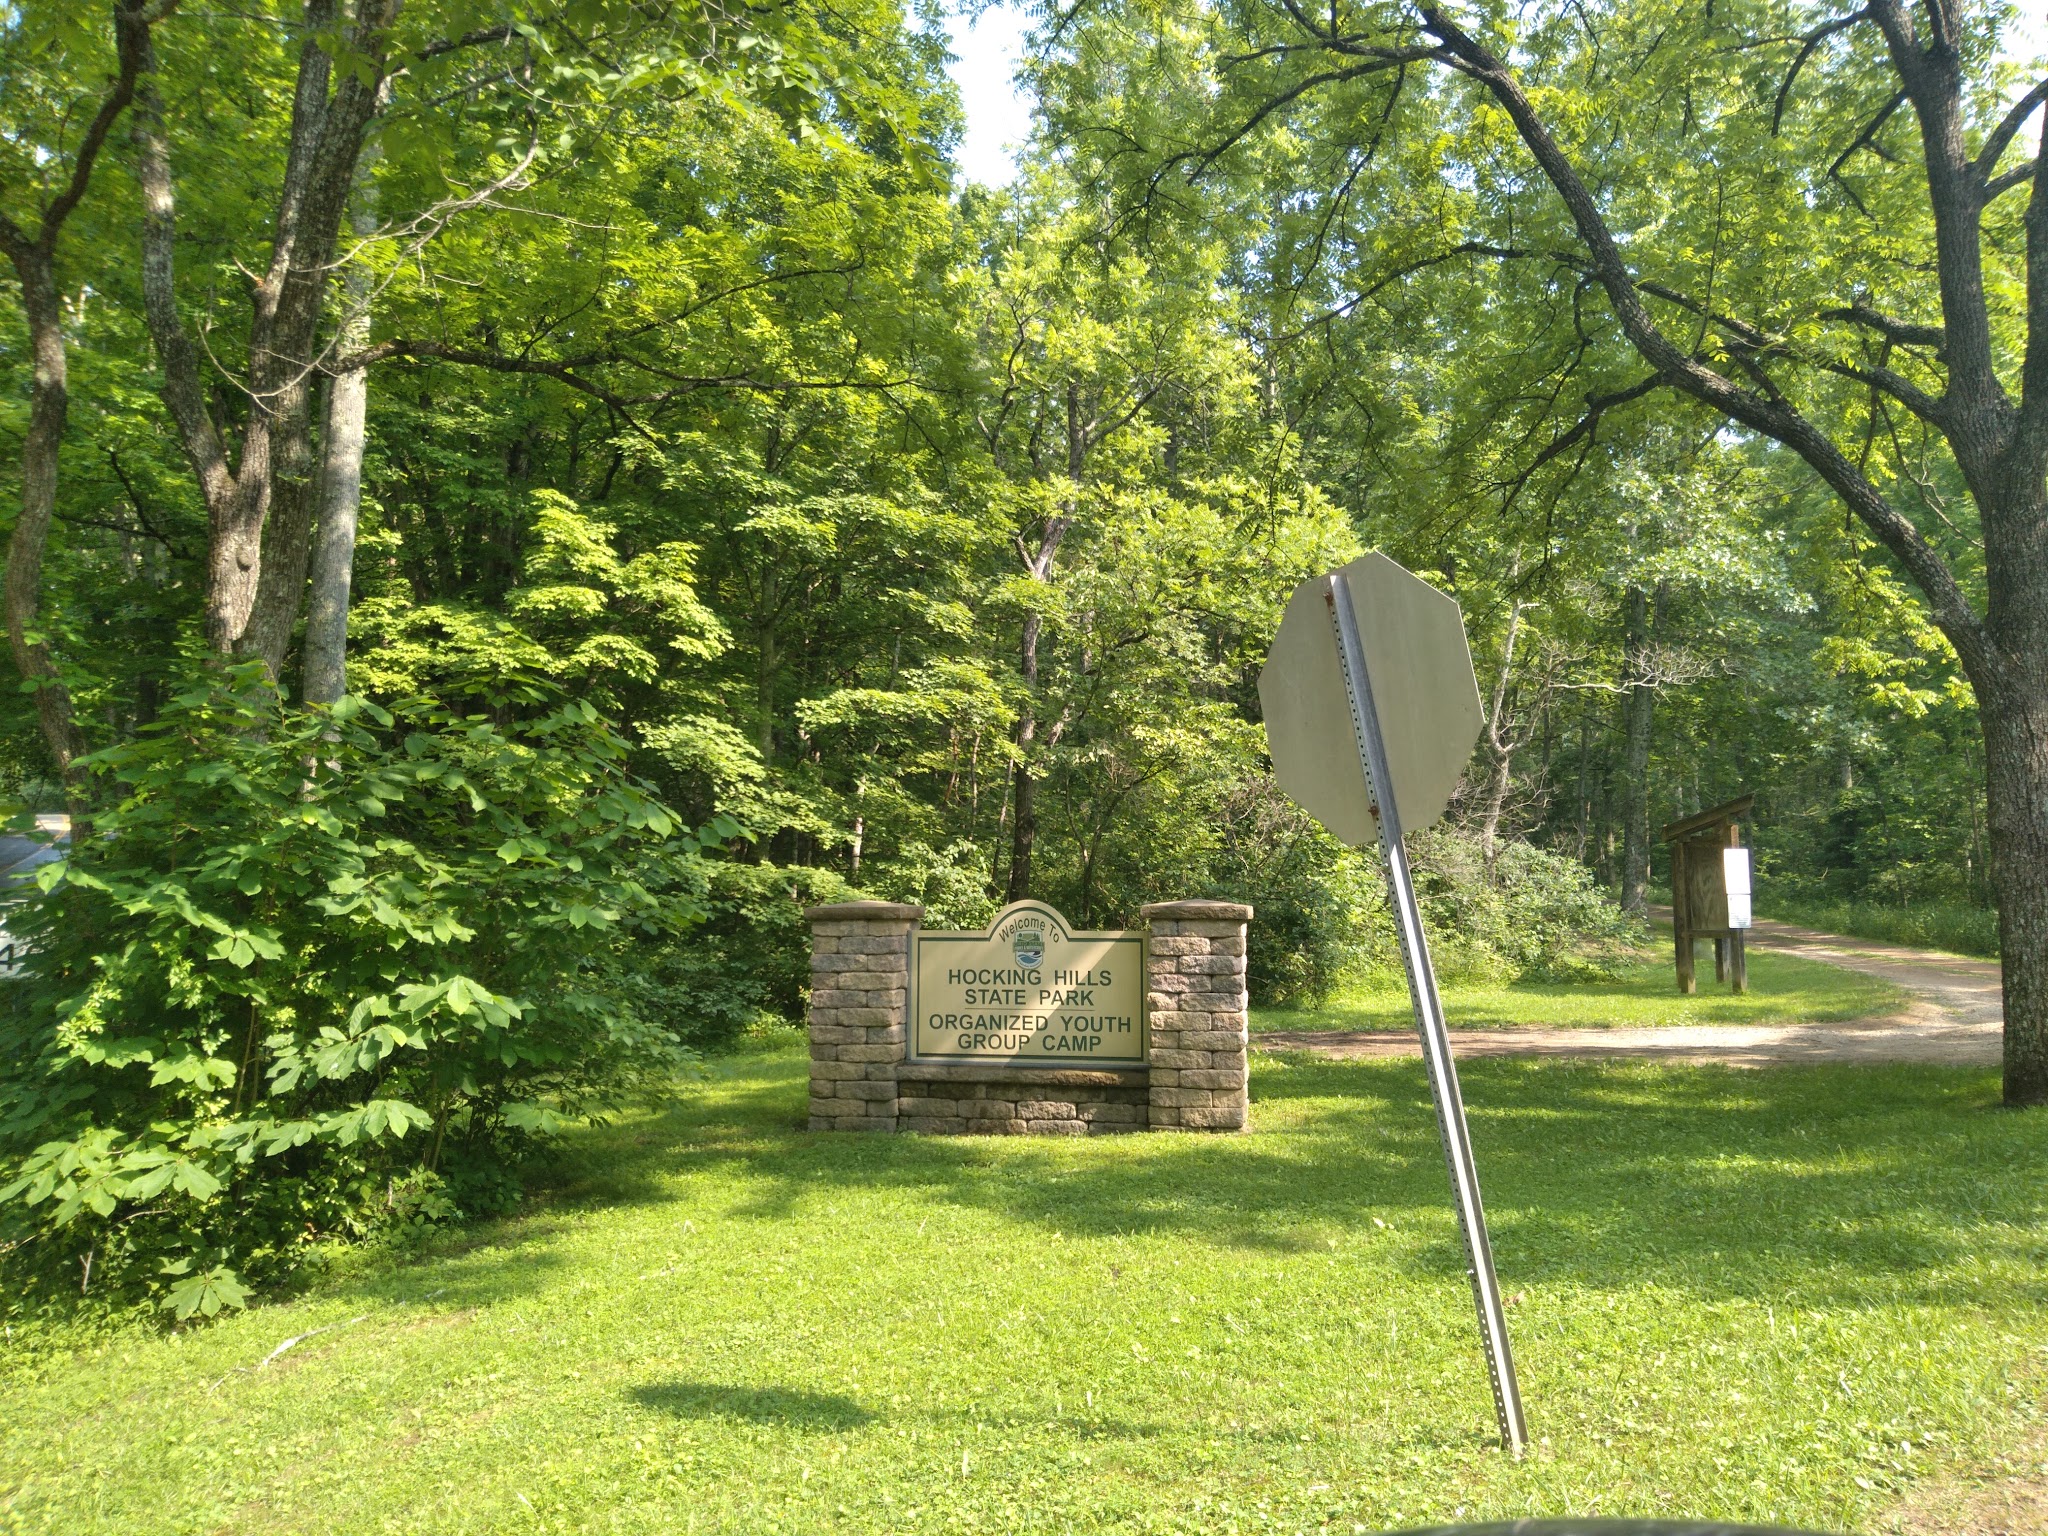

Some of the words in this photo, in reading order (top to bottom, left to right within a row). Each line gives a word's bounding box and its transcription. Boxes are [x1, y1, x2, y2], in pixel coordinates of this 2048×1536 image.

[998, 917, 1046, 943] Welcome
[1049, 923, 1060, 943] To
[949, 969, 1041, 985] HOCKING
[1055, 970, 1112, 986] HILLS
[965, 989, 1026, 1005] STATE
[1039, 990, 1094, 1006] PARK
[929, 1014, 1048, 1031] ORGANIZED
[1061, 1016, 1131, 1032] YOUTH
[958, 1034, 1030, 1050] GROUP
[1042, 1036, 1102, 1052] CAMP
